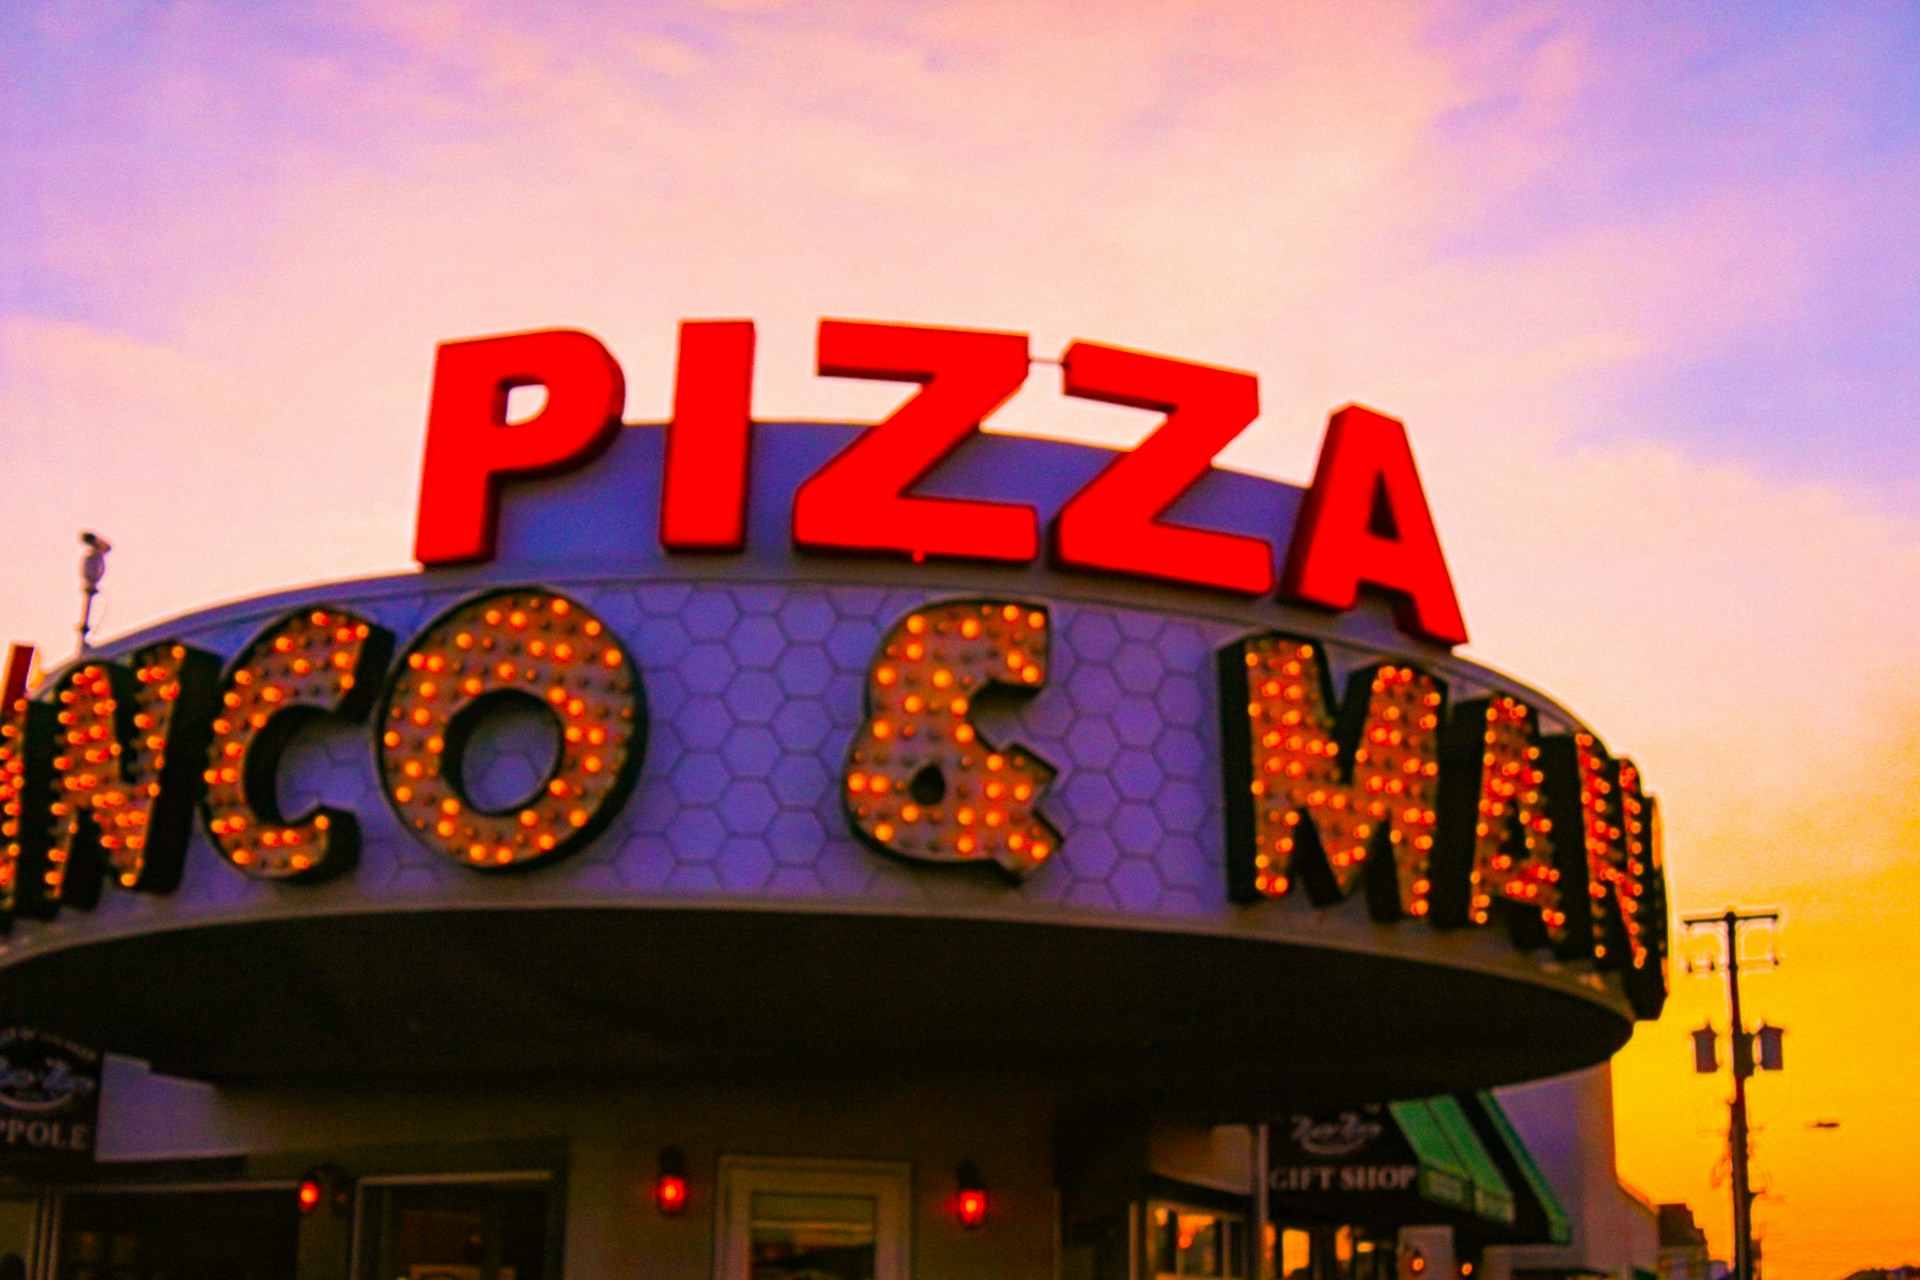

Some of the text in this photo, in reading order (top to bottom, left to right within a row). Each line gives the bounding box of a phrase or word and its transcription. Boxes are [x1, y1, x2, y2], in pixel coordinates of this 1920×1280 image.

[413, 318, 1468, 645] PIZZA
[845, 597, 1063, 883] &
[1216, 630, 1669, 1018] MAN
[1270, 1165, 1337, 1192] GIFT
[1340, 1164, 1418, 1192] SHOP
